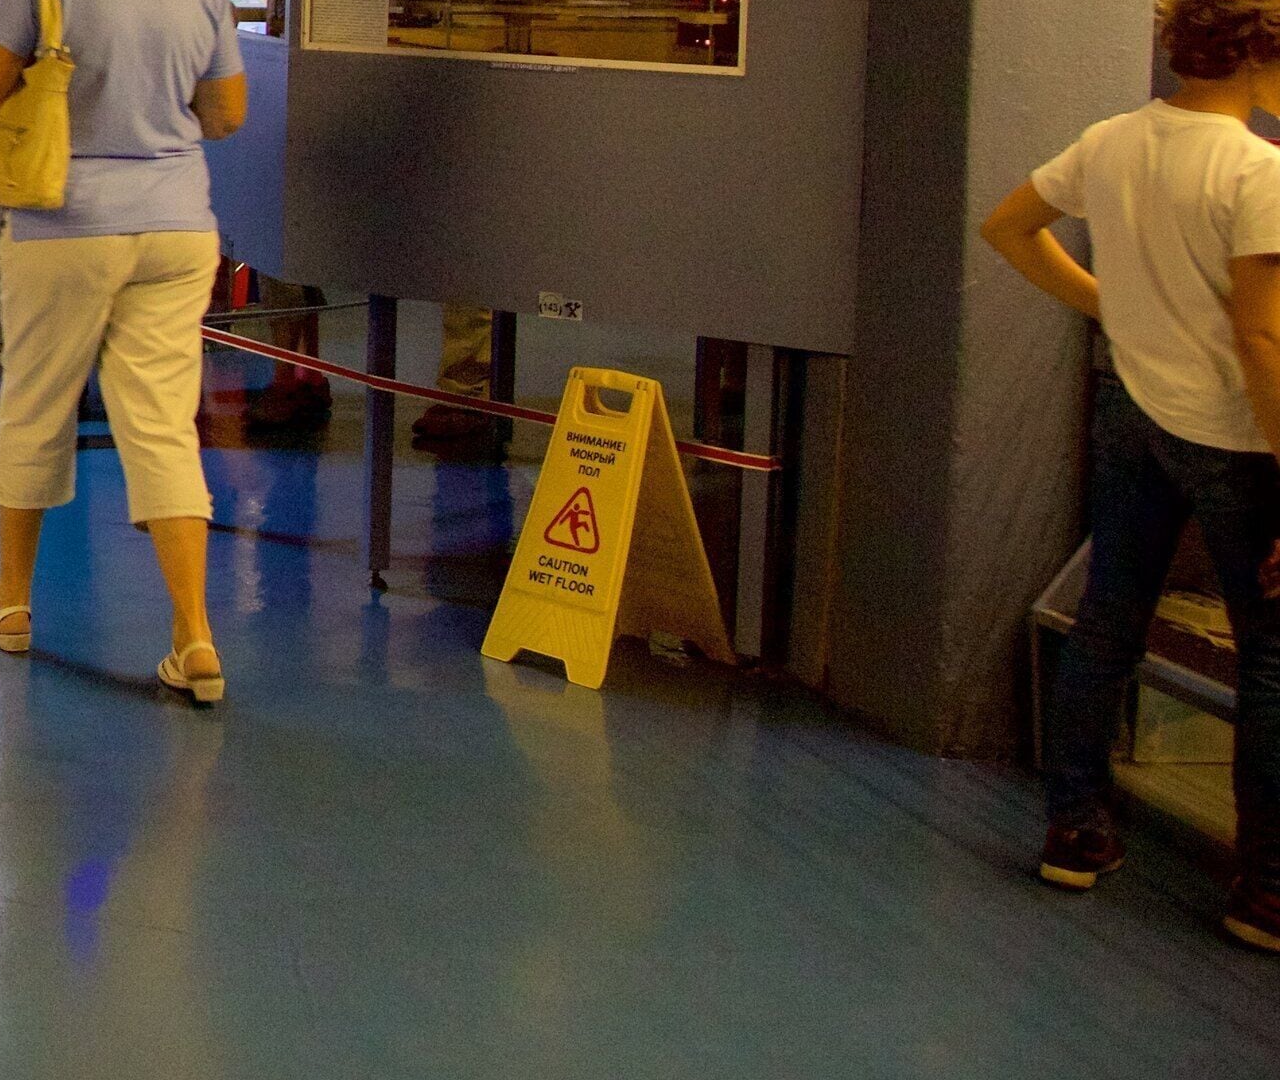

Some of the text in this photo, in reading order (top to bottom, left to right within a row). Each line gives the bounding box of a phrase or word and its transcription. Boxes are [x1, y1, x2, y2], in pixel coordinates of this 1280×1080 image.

[566, 431, 627, 452] ВНИМАНИЕ!
[570, 448, 616, 465] МОКРЫЙ
[578, 464, 600, 477] ПОЛ
[538, 555, 589, 577] CAUTION
[528, 569, 595, 596] WET FLOOR
